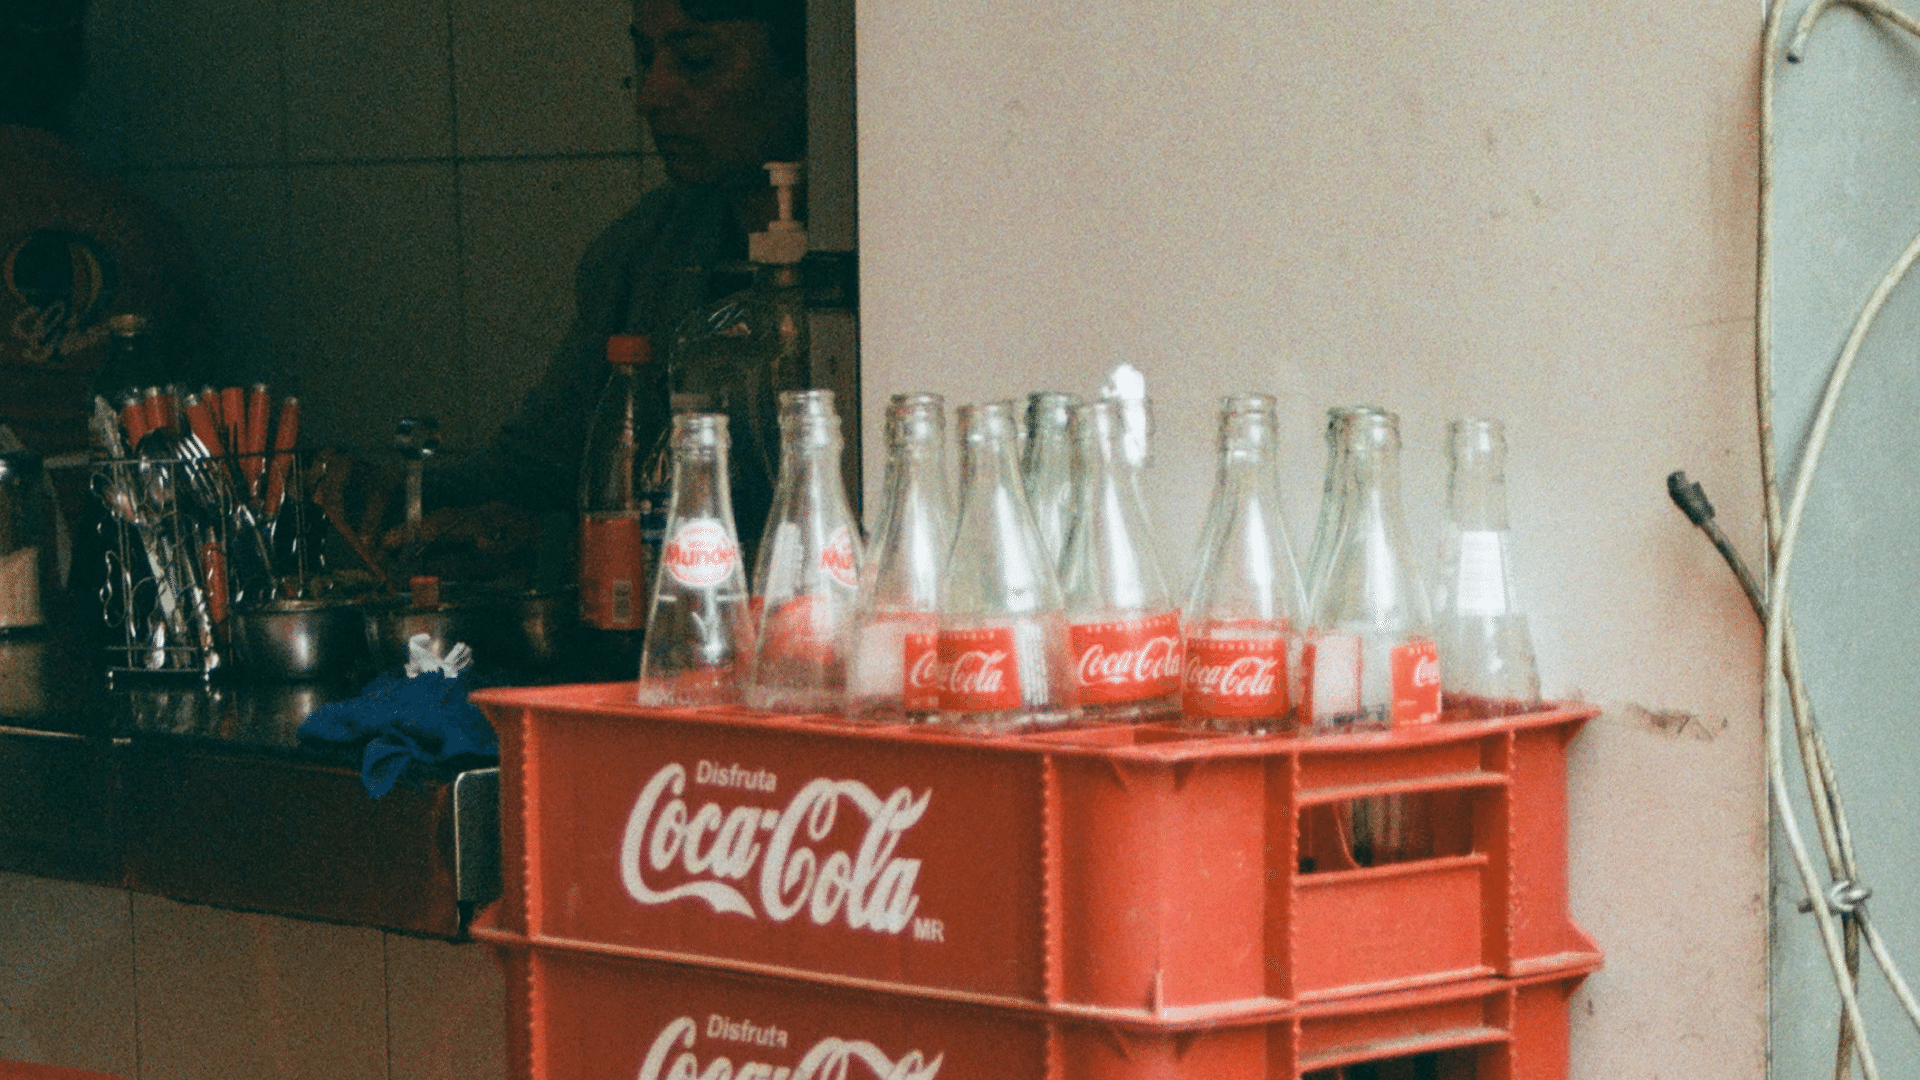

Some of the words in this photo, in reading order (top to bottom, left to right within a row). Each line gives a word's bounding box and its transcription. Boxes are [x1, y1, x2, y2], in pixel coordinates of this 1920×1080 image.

[695, 759, 778, 793] Disfruta
[620, 762, 933, 935] Coca-Cola
[913, 917, 946, 943] MR
[706, 1013, 789, 1049] Disfruta
